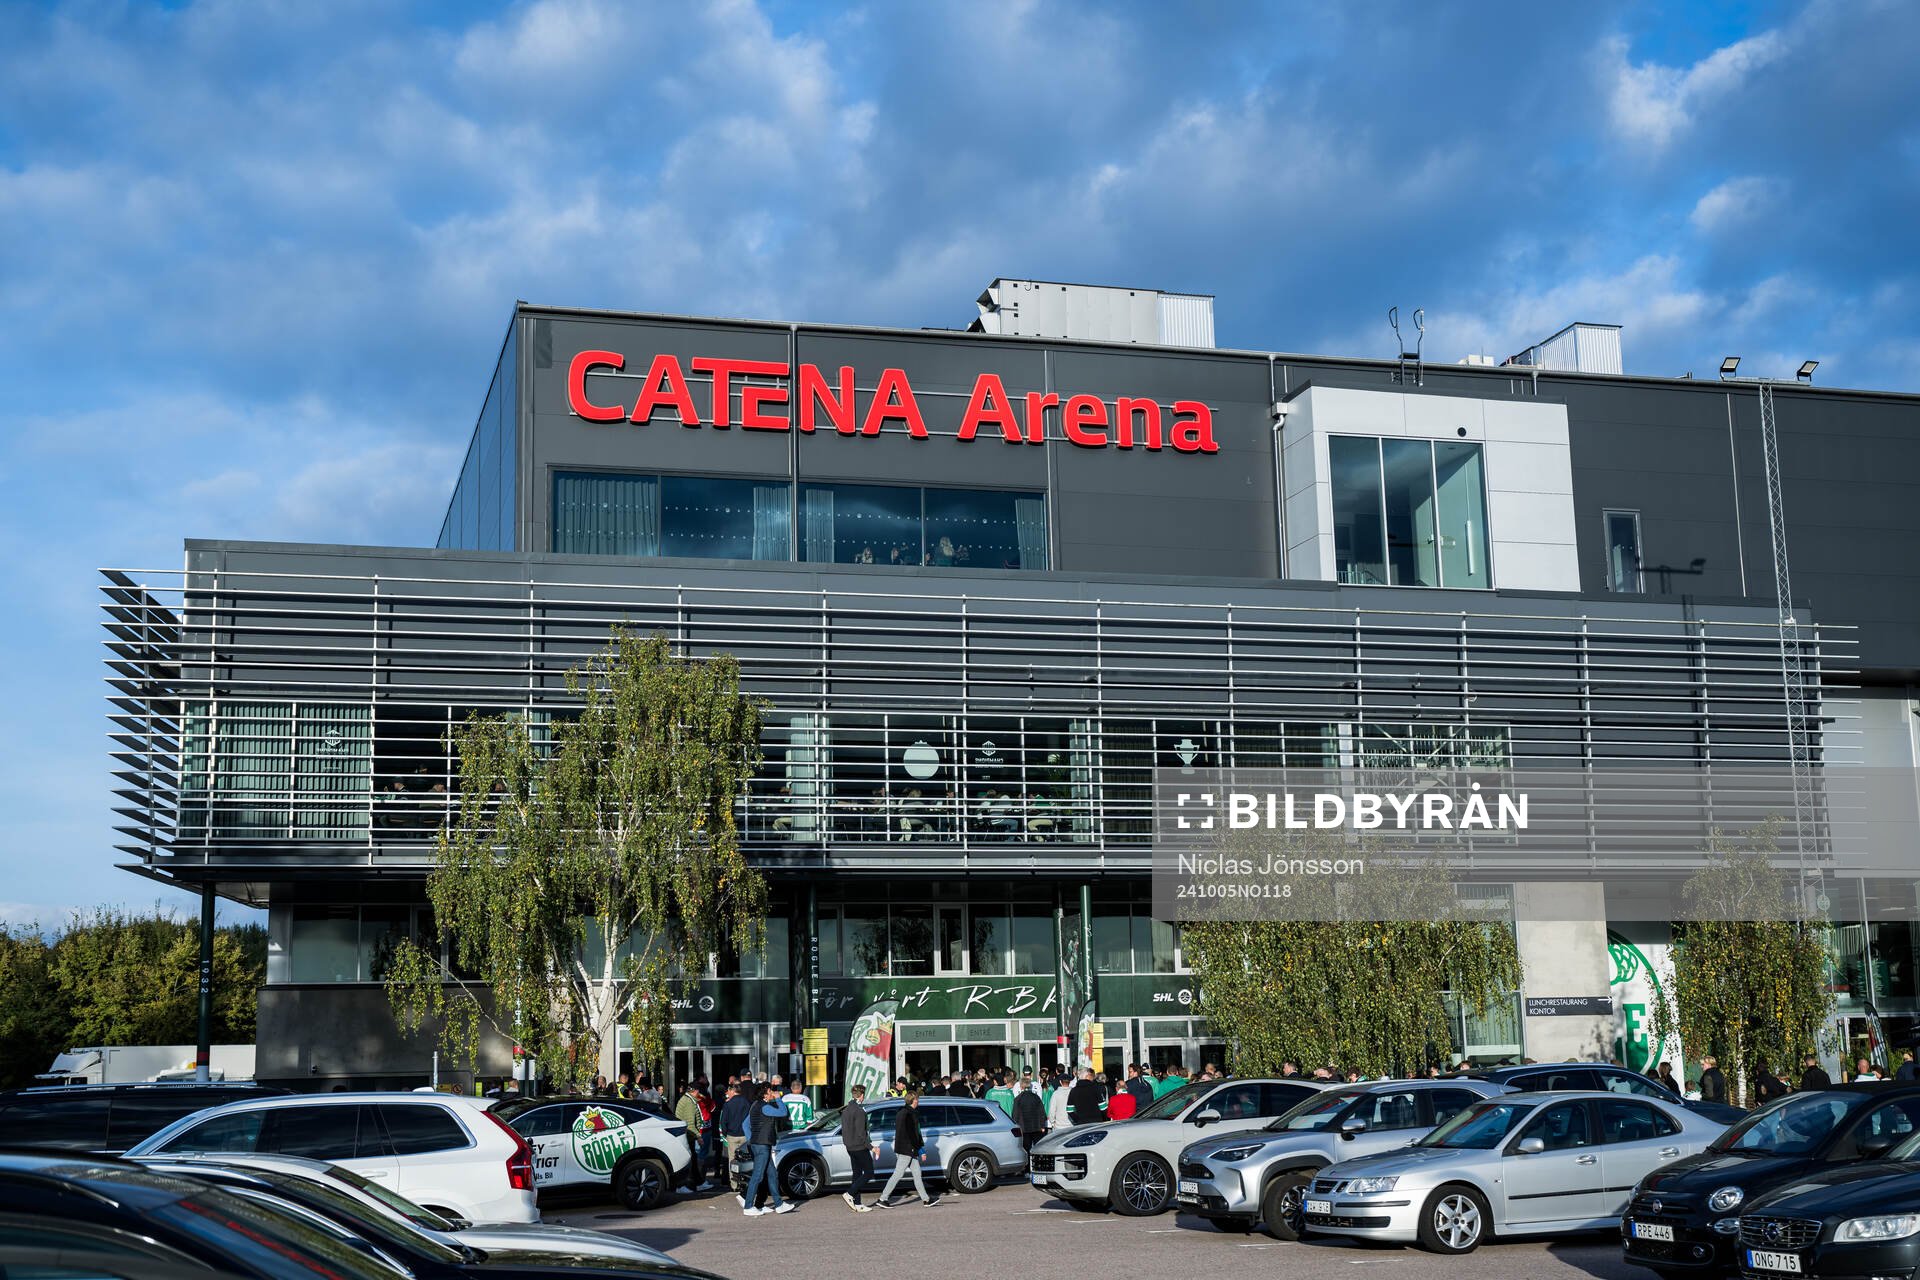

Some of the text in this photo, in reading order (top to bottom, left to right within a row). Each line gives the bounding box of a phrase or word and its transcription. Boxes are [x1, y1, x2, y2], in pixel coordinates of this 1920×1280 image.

[567, 350, 1219, 453] CATENA Arena
[201, 960, 210, 993] 1932
[670, 999, 694, 1009] SHL
[1152, 993, 1174, 1002] SHL
[1529, 998, 1588, 1006] LUNCHRESTAURANG
[788, 1103, 804, 1121] 71
[582, 1130, 631, 1171] RÖGLE
[1637, 1224, 1671, 1240] RPE 446
[1755, 1252, 1797, 1270] ONG 715
